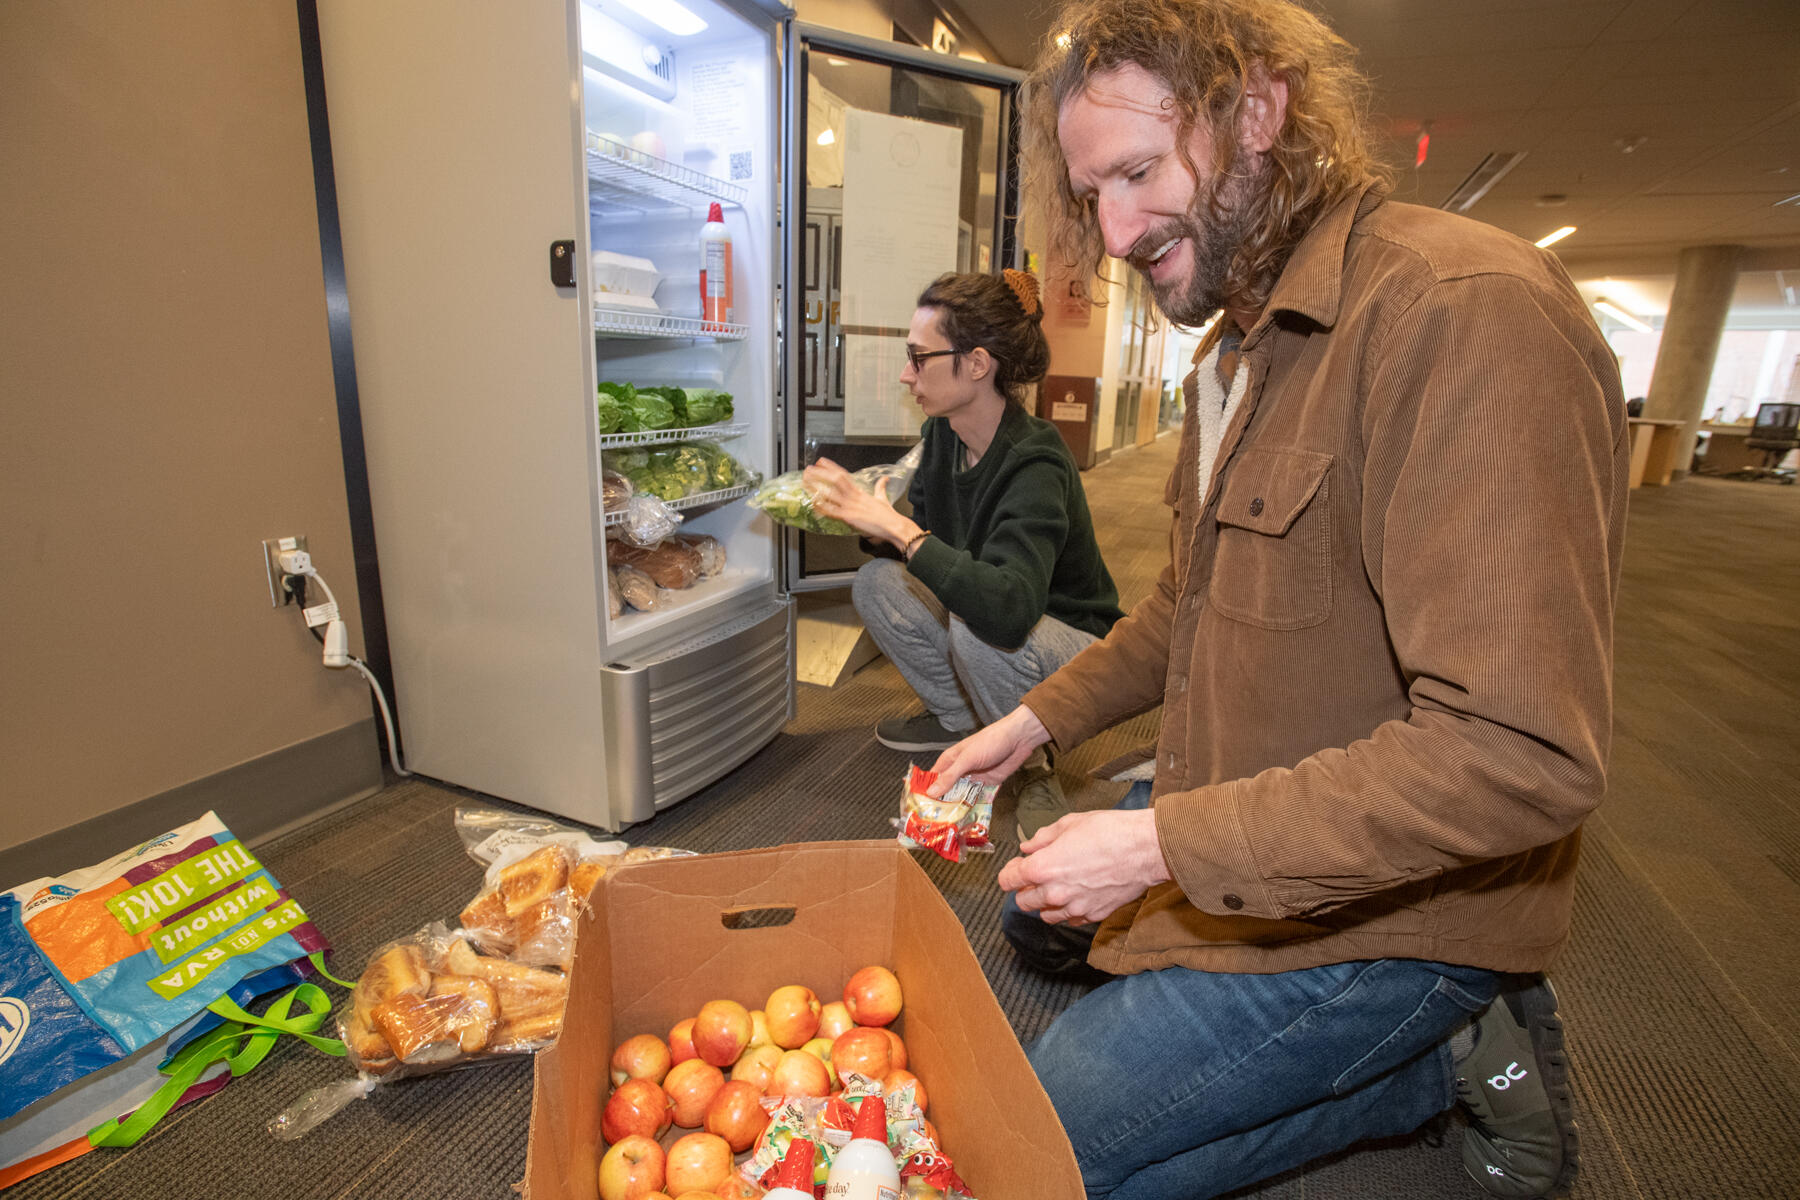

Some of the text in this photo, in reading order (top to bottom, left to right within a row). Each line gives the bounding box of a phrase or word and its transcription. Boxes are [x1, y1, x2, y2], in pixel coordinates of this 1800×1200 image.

[118, 845, 255, 925] THE 10K!
[161, 884, 267, 951] without
[231, 929, 260, 950] NOT
[160, 947, 226, 988] RVA
